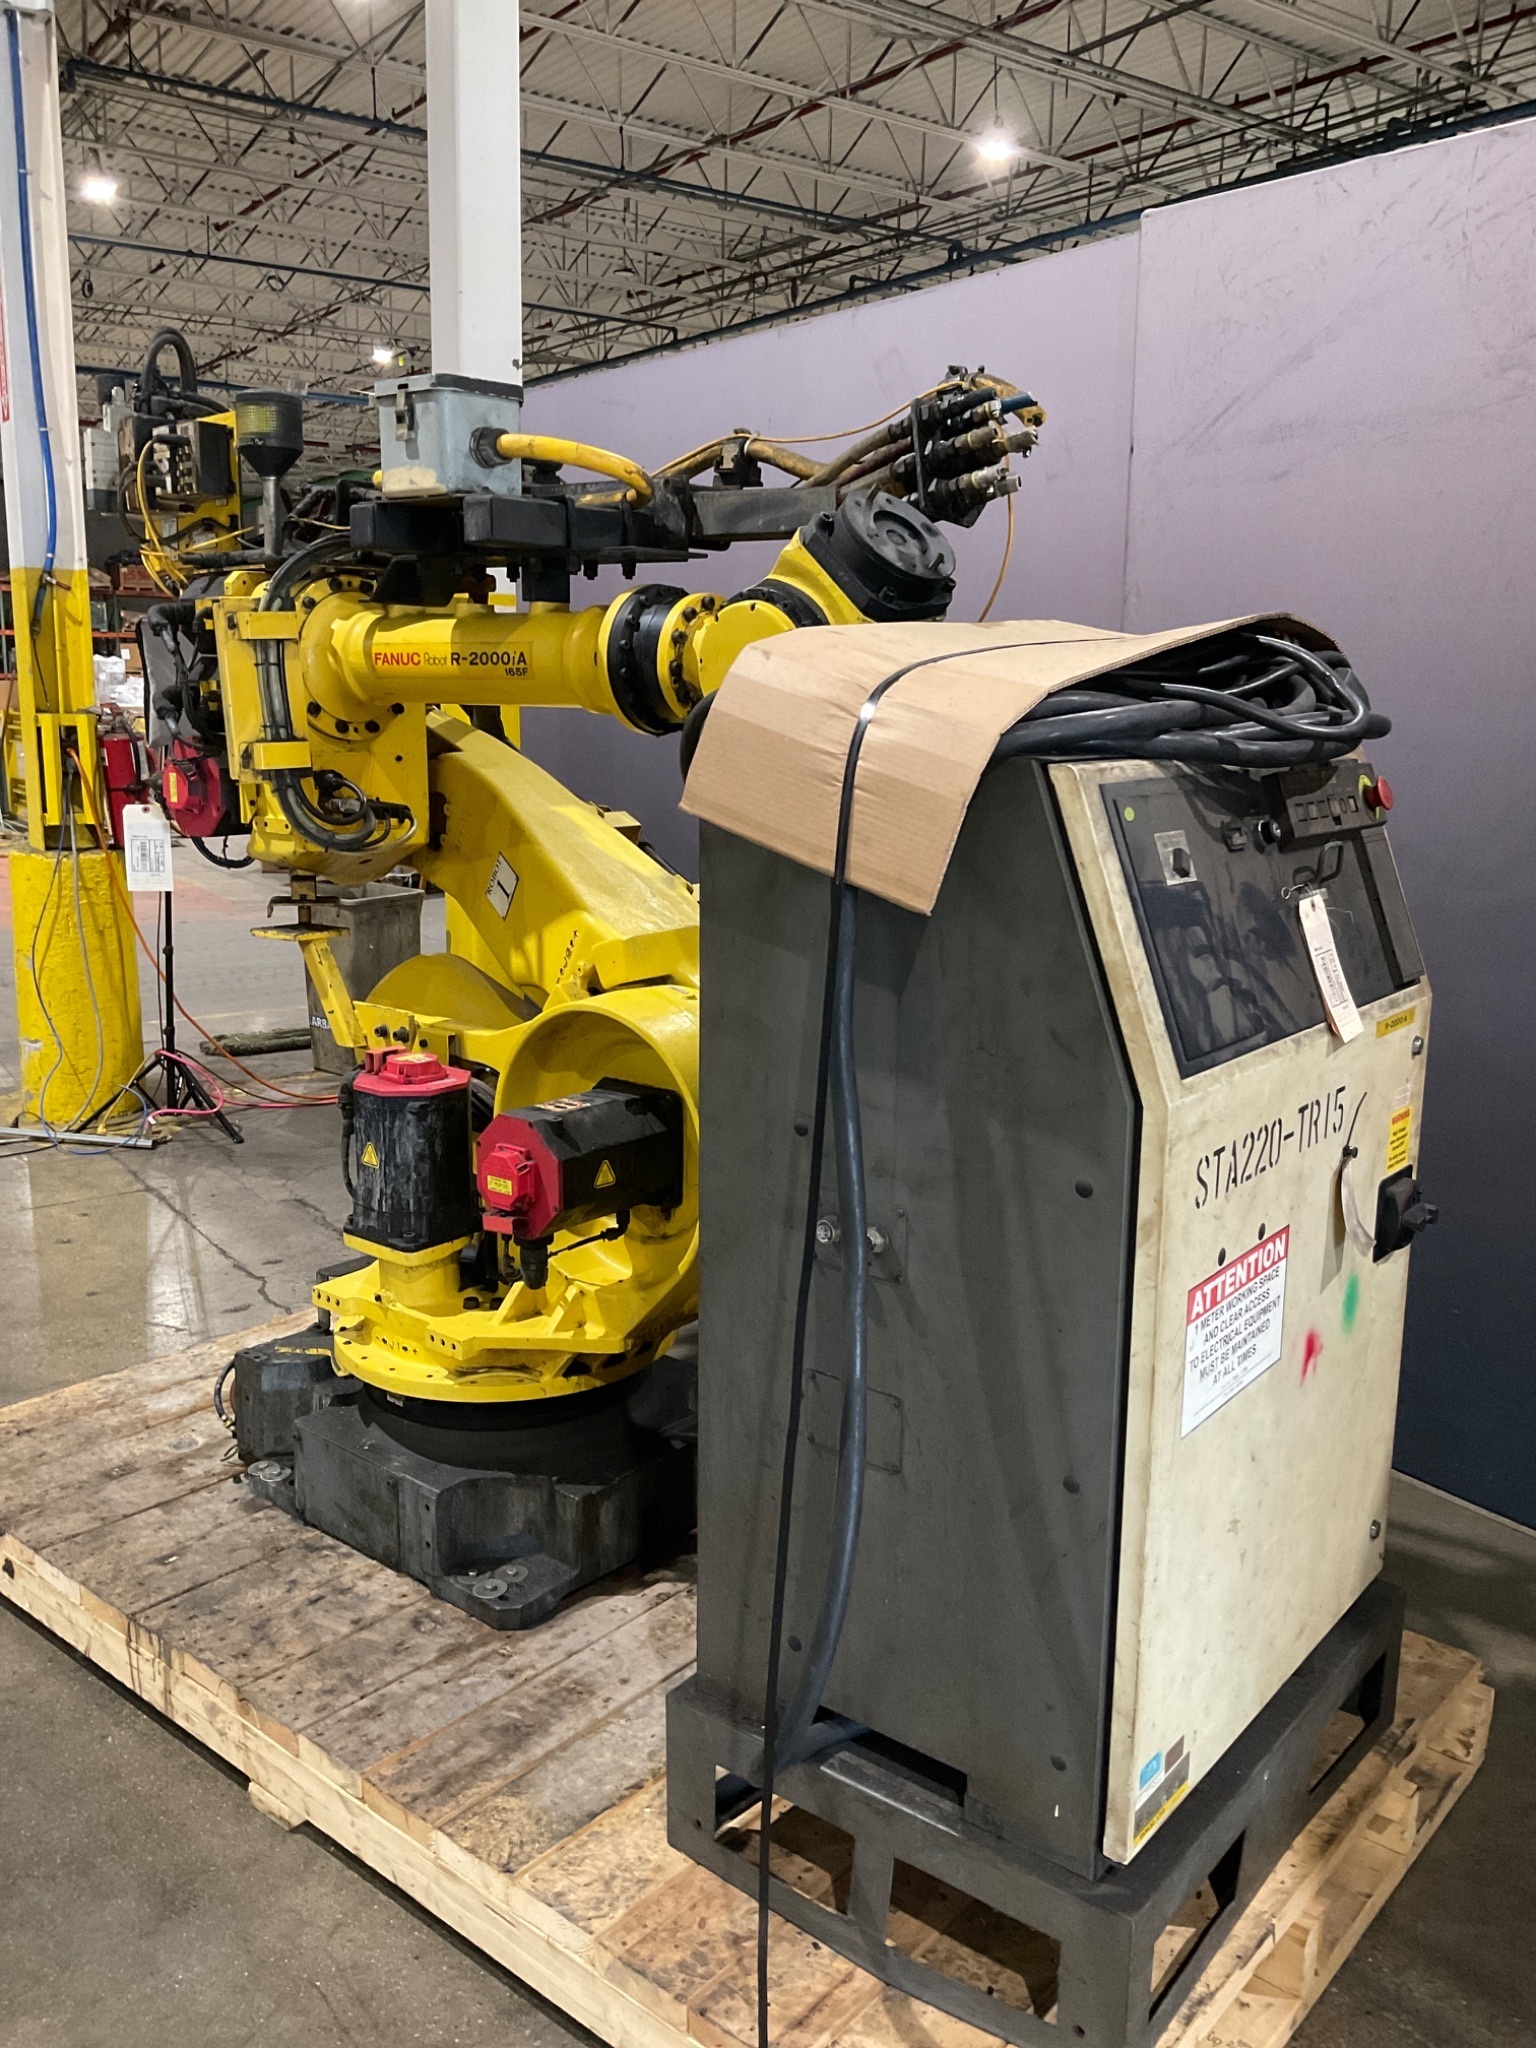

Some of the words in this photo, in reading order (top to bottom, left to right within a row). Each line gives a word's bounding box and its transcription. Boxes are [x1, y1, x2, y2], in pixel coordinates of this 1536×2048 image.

[374, 652, 421, 666] FANUC
[423, 652, 447, 666] Robot
[451, 650, 527, 667] R-2000iA
[505, 667, 528, 677] 165F
[497, 880, 510, 901] 1
[1195, 1085, 1346, 1209] STA220-TR15
[1190, 1232, 1286, 1321] ATTENTION
[1194, 1323, 1199, 1335] 1
[1201, 1305, 1225, 1331] METER
[1226, 1281, 1258, 1312] WORKING
[1259, 1266, 1280, 1289] SPACE
[1189, 1356, 1200, 1372] TO
[1200, 1323, 1243, 1364] ELECTRICAL
[1243, 1295, 1281, 1331] EQUIPMENT
[1204, 1325, 1219, 1346] AND
[1220, 1308, 1243, 1333] CLEAR
[1244, 1288, 1271, 1316] ACCESS
[1200, 1356, 1219, 1381] MUST
[1220, 1348, 1230, 1365] BE
[1231, 1318, 1271, 1356] MAINTAINED
[1212, 1370, 1222, 1387] AT
[1222, 1360, 1236, 1378] ALL
[1237, 1344, 1257, 1367] TIMES
